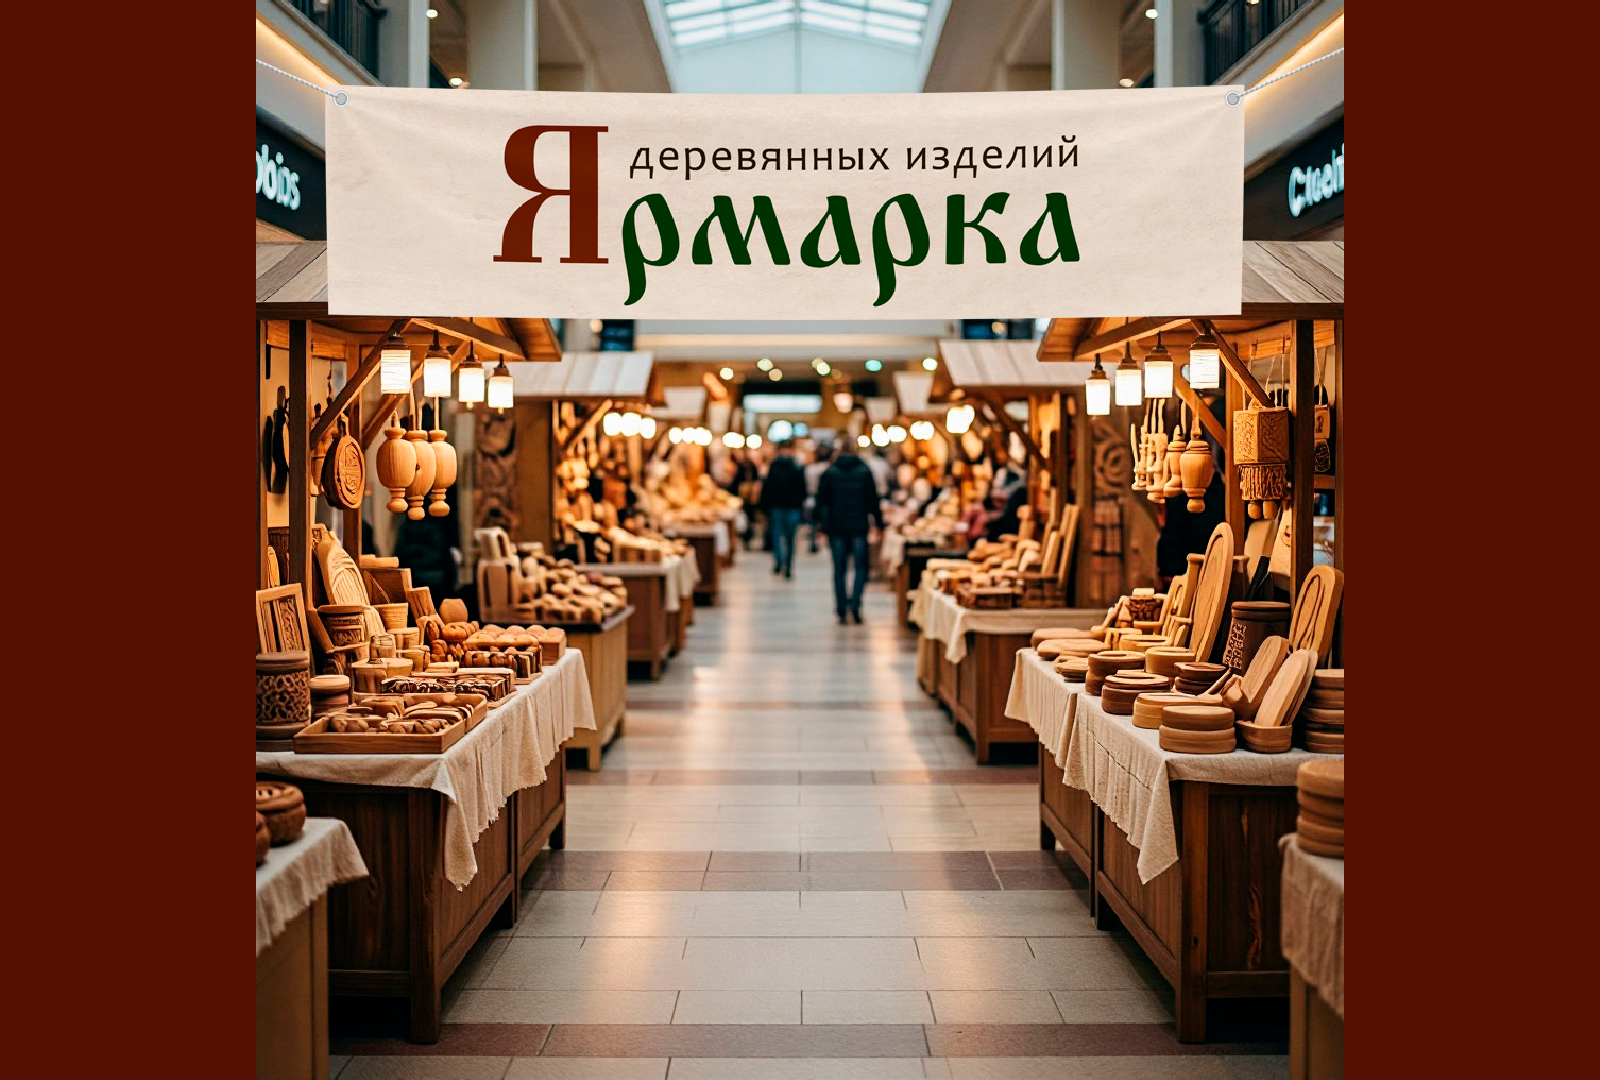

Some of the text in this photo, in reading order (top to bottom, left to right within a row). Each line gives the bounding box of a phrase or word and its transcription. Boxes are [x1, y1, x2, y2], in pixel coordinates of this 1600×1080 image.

[630, 135, 1080, 181] деревянных изделий
[493, 125, 1080, 306] Ярмарка
